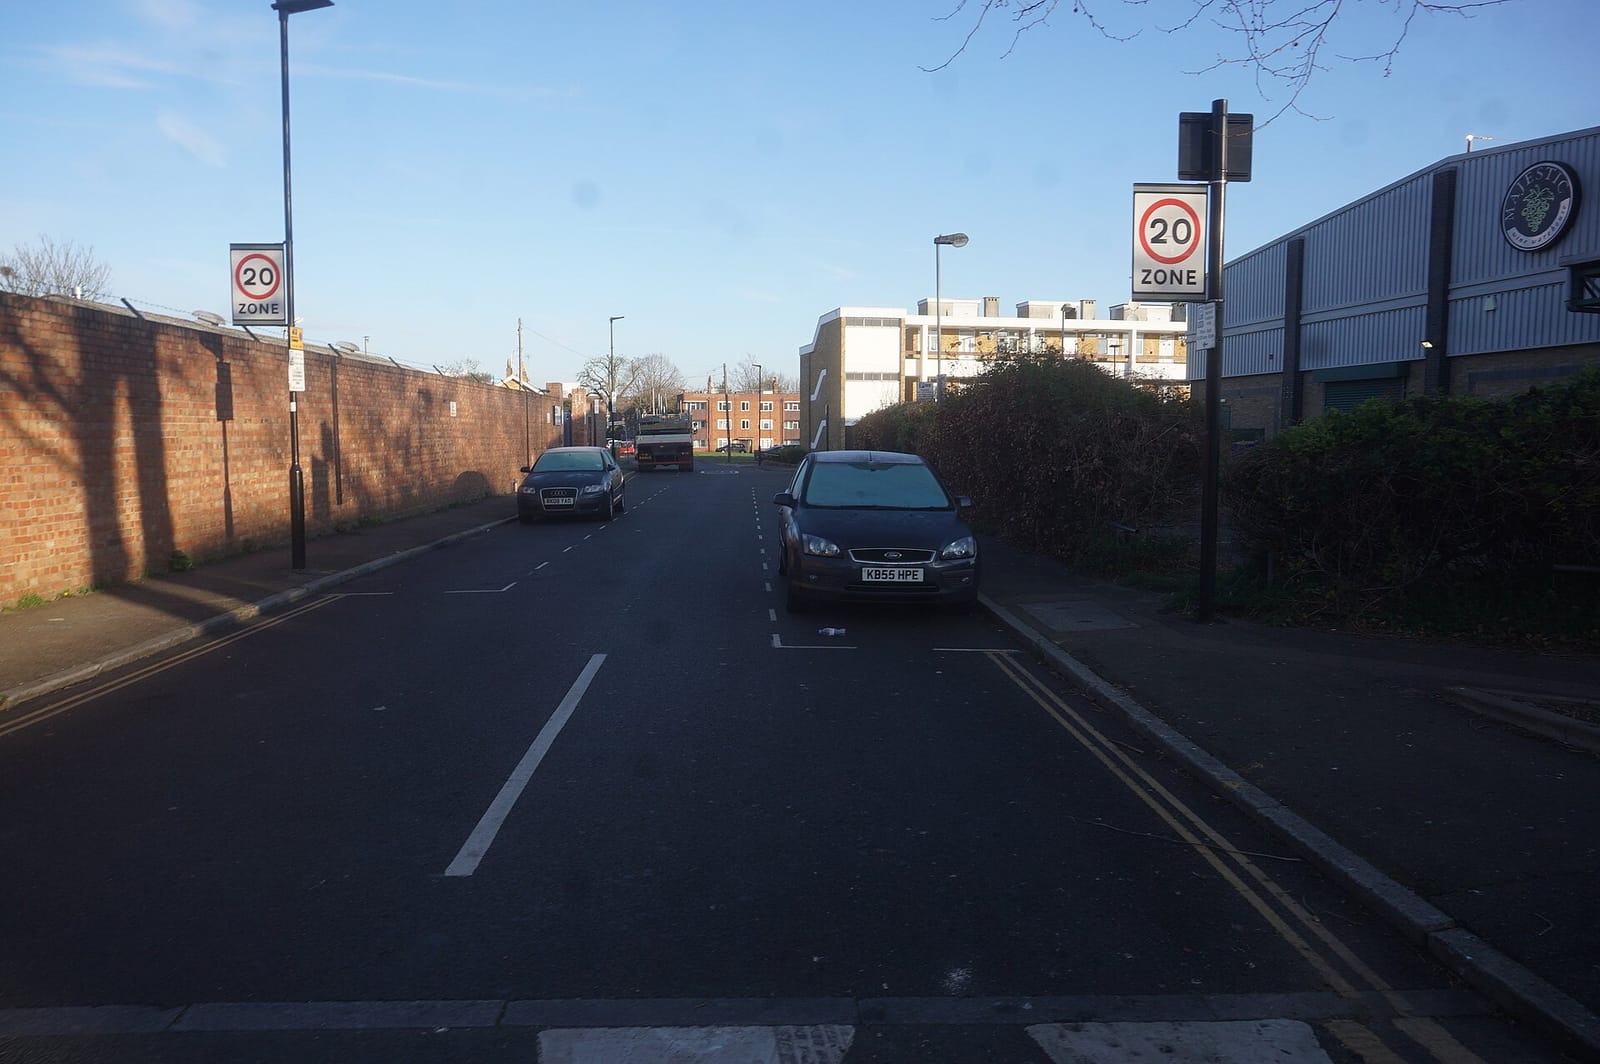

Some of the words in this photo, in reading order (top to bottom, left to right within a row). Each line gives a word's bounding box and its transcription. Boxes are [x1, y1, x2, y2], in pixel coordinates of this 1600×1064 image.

[1504, 166, 1570, 221] MAJESTIC
[1150, 218, 1192, 245] 20
[243, 267, 274, 286] 20
[1141, 269, 1197, 286] ZONE
[238, 303, 279, 315] ZONE
[866, 569, 895, 580] KB55
[898, 569, 919, 580] HPE
